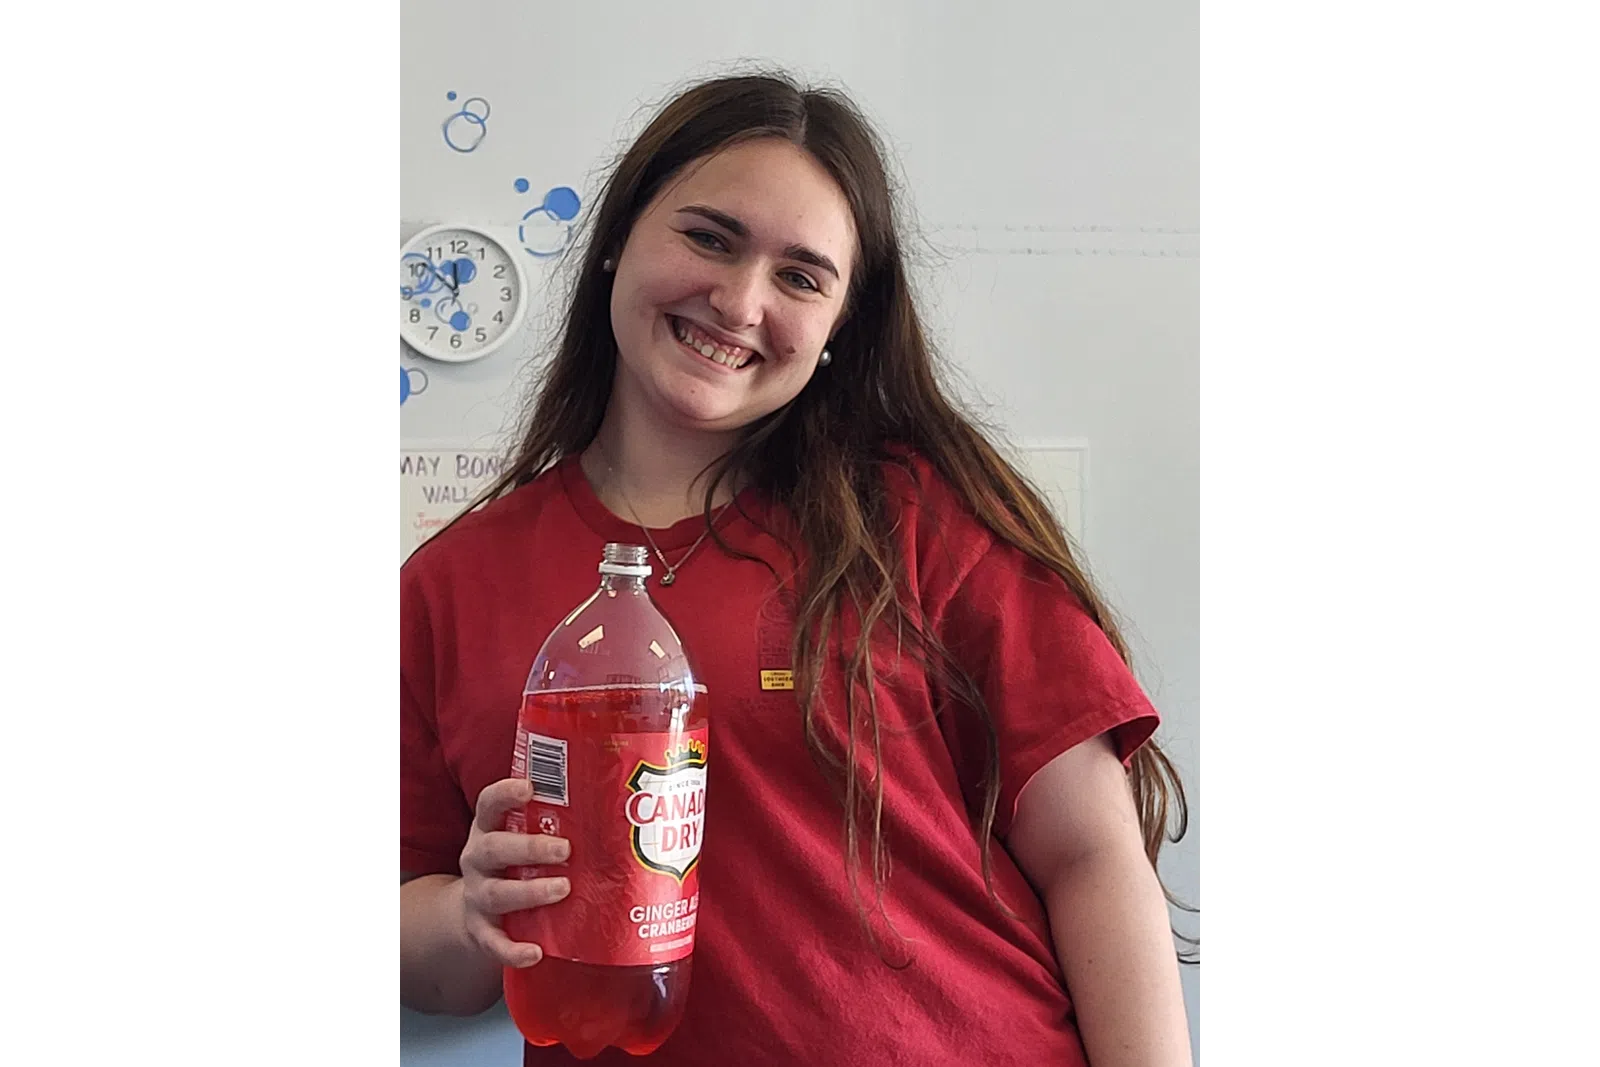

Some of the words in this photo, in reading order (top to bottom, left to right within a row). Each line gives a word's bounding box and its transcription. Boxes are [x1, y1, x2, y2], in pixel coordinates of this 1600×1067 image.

[426, 247, 442, 260] 11
[450, 240, 469, 254] 12
[478, 247, 485, 260] 1
[409, 262, 426, 278] 10
[493, 265, 505, 279] 2
[402, 287, 413, 301] 9
[500, 287, 512, 301] 3
[409, 308, 421, 323] 8
[492, 310, 503, 324] 4
[426, 326, 439, 340] 7
[475, 328, 487, 342] 5
[450, 334, 462, 349] 6
[629, 788, 705, 825] CANAD
[661, 819, 701, 852] DRY
[629, 898, 689, 924] GINGER
